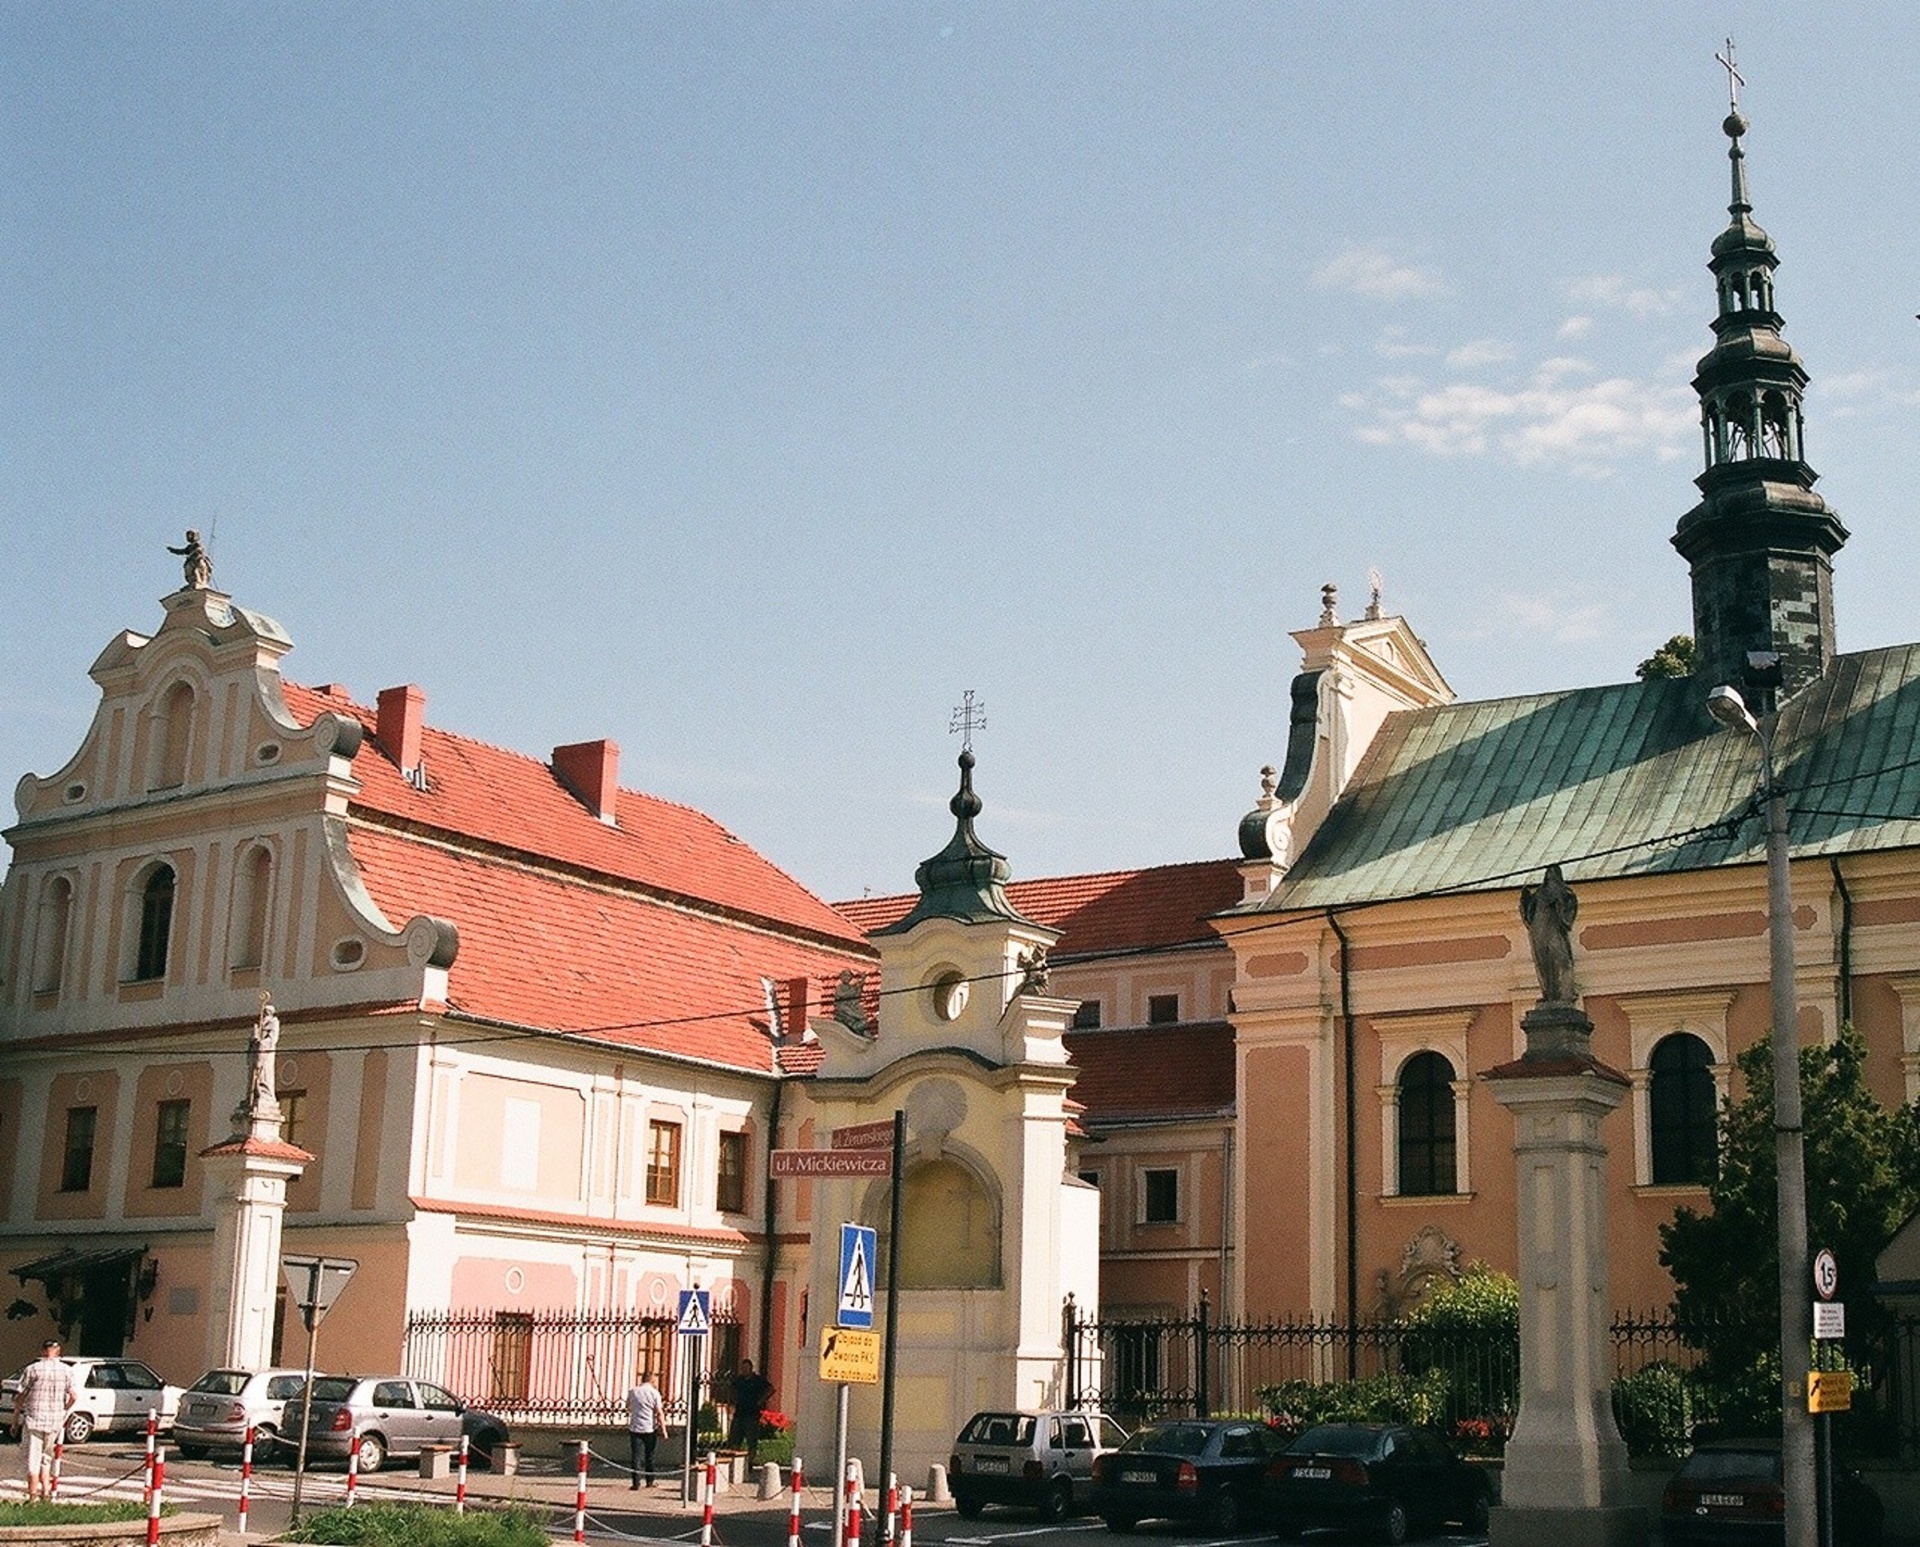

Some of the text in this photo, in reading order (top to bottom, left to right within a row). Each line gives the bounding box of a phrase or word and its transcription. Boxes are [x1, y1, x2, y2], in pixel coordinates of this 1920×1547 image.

[843, 1127, 895, 1149] Żeromskiego
[776, 1155, 887, 1171] ul. Mickiewicza
